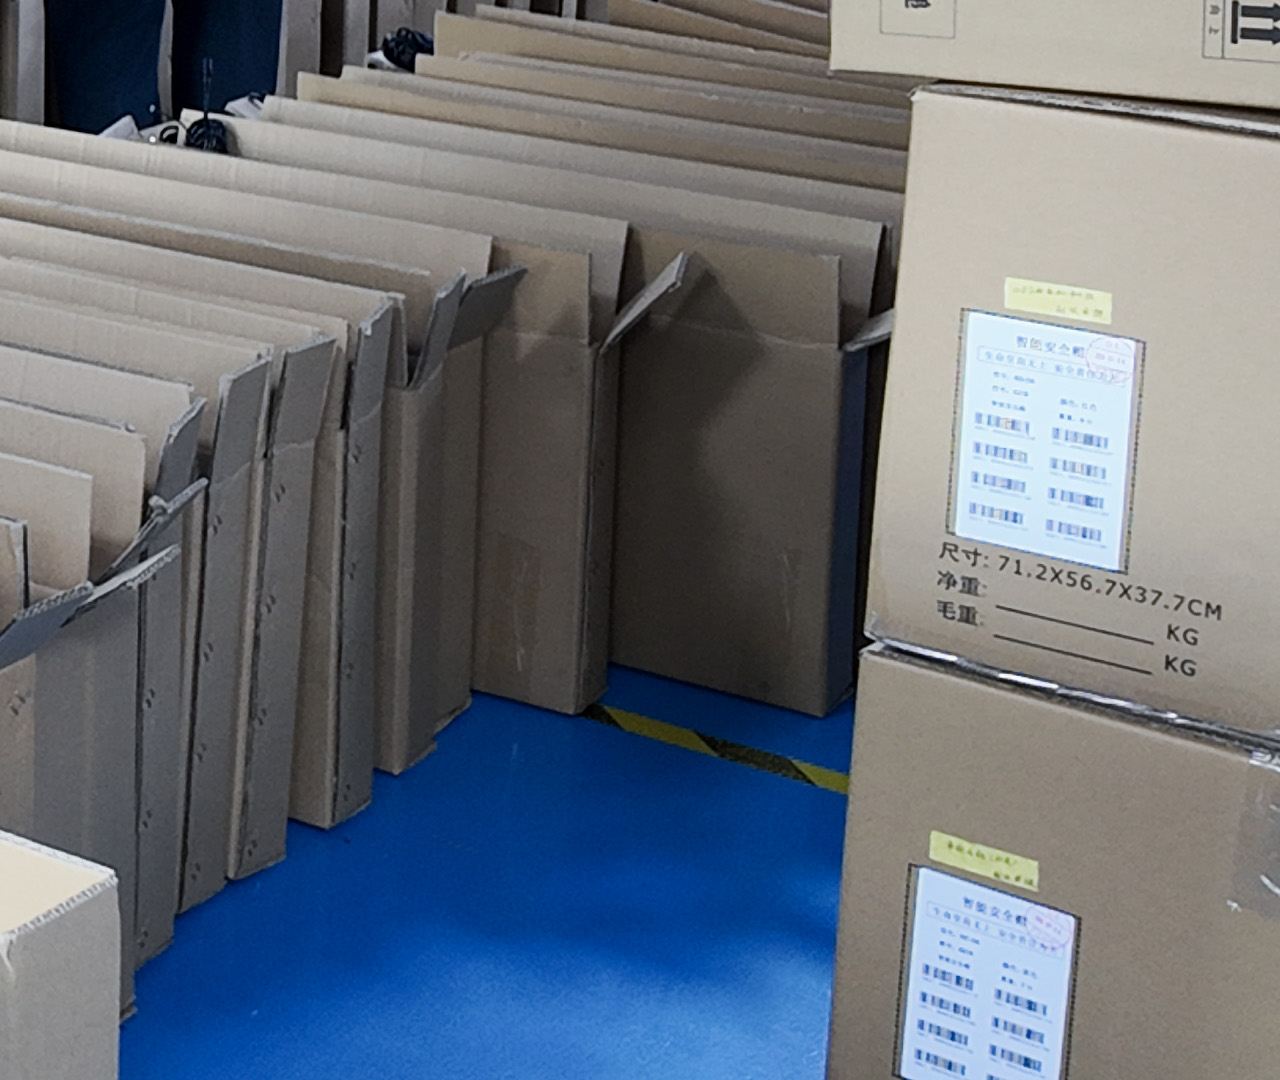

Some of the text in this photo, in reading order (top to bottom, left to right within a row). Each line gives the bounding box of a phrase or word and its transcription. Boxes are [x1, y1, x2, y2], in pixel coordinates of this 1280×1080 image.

[998, 555, 1222, 621] 71.2X56.7X37.7CM
[1166, 623, 1199, 646] KG
[1164, 654, 1197, 678] KG
